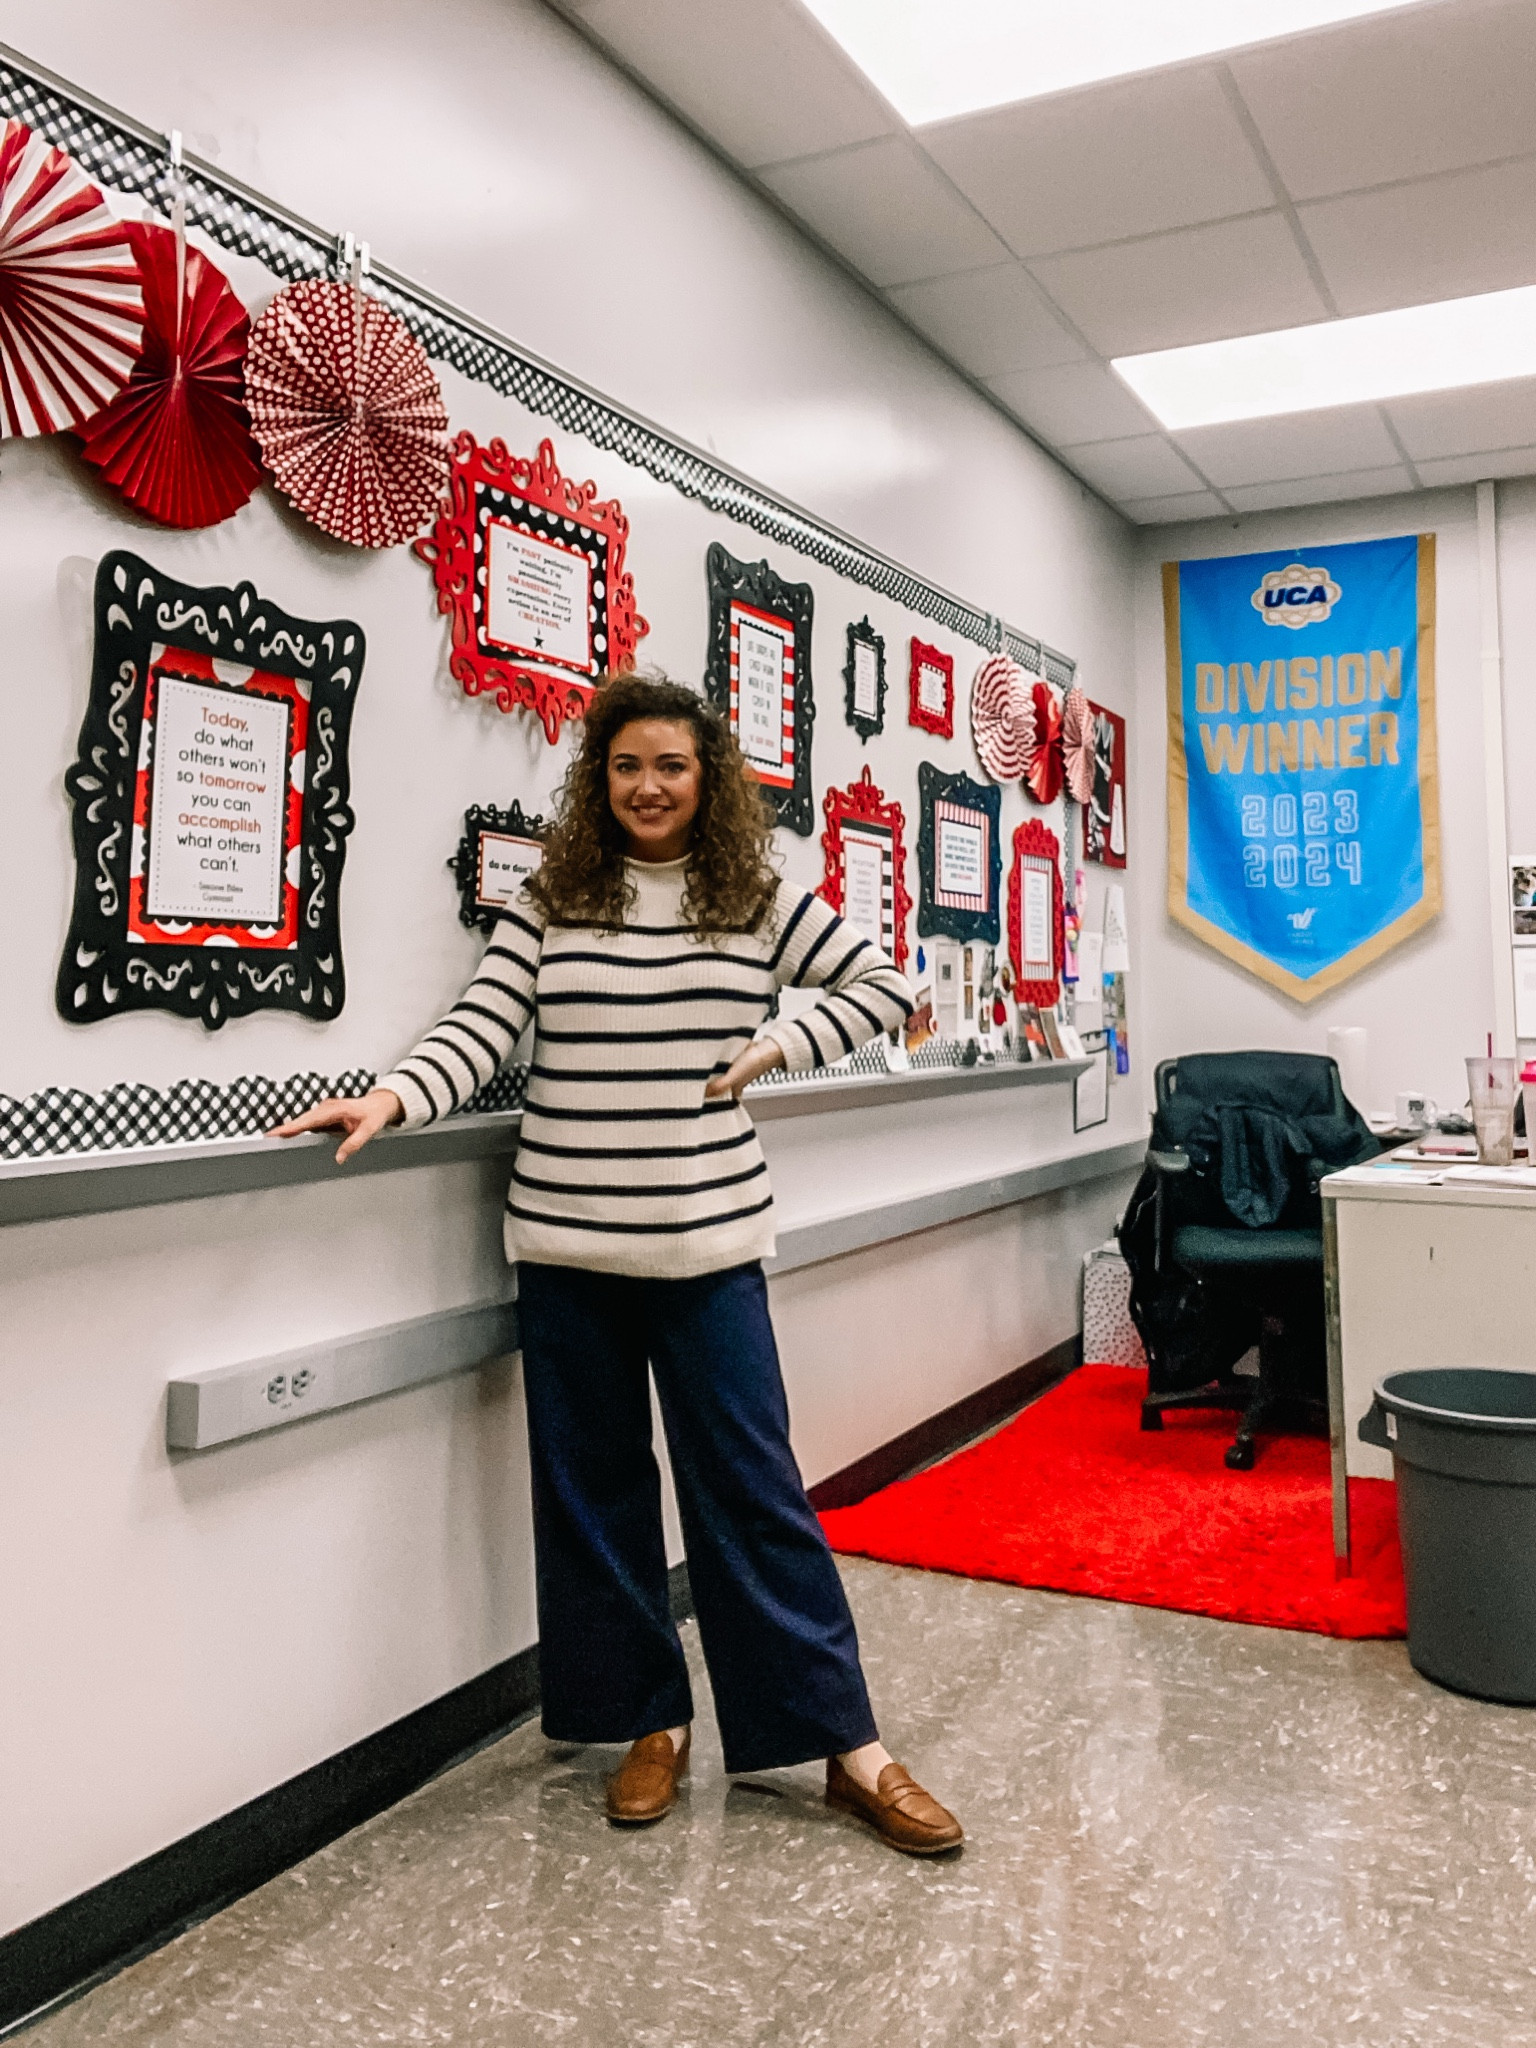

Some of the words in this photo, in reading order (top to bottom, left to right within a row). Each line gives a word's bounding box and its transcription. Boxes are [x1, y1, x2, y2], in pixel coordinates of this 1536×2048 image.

[1263, 585, 1327, 607] UCA
[1195, 647, 1402, 714] DIVISION
[201, 706, 249, 732] Today,
[194, 728, 215, 745] do
[220, 734, 253, 752] what
[1199, 711, 1400, 774] WINNER
[178, 748, 224, 767] others
[229, 758, 266, 773] won't
[176, 770, 194, 783] so
[199, 771, 266, 793] tomorrow
[191, 794, 219, 808] you
[223, 798, 251, 812] can
[1241, 789, 1359, 838] 2023
[178, 812, 261, 834] accomplish
[177, 831, 212, 848] what
[217, 837, 261, 854] others
[199, 855, 238, 872] can't.
[489, 860, 499, 869] do
[1242, 841, 1362, 888] 2024
